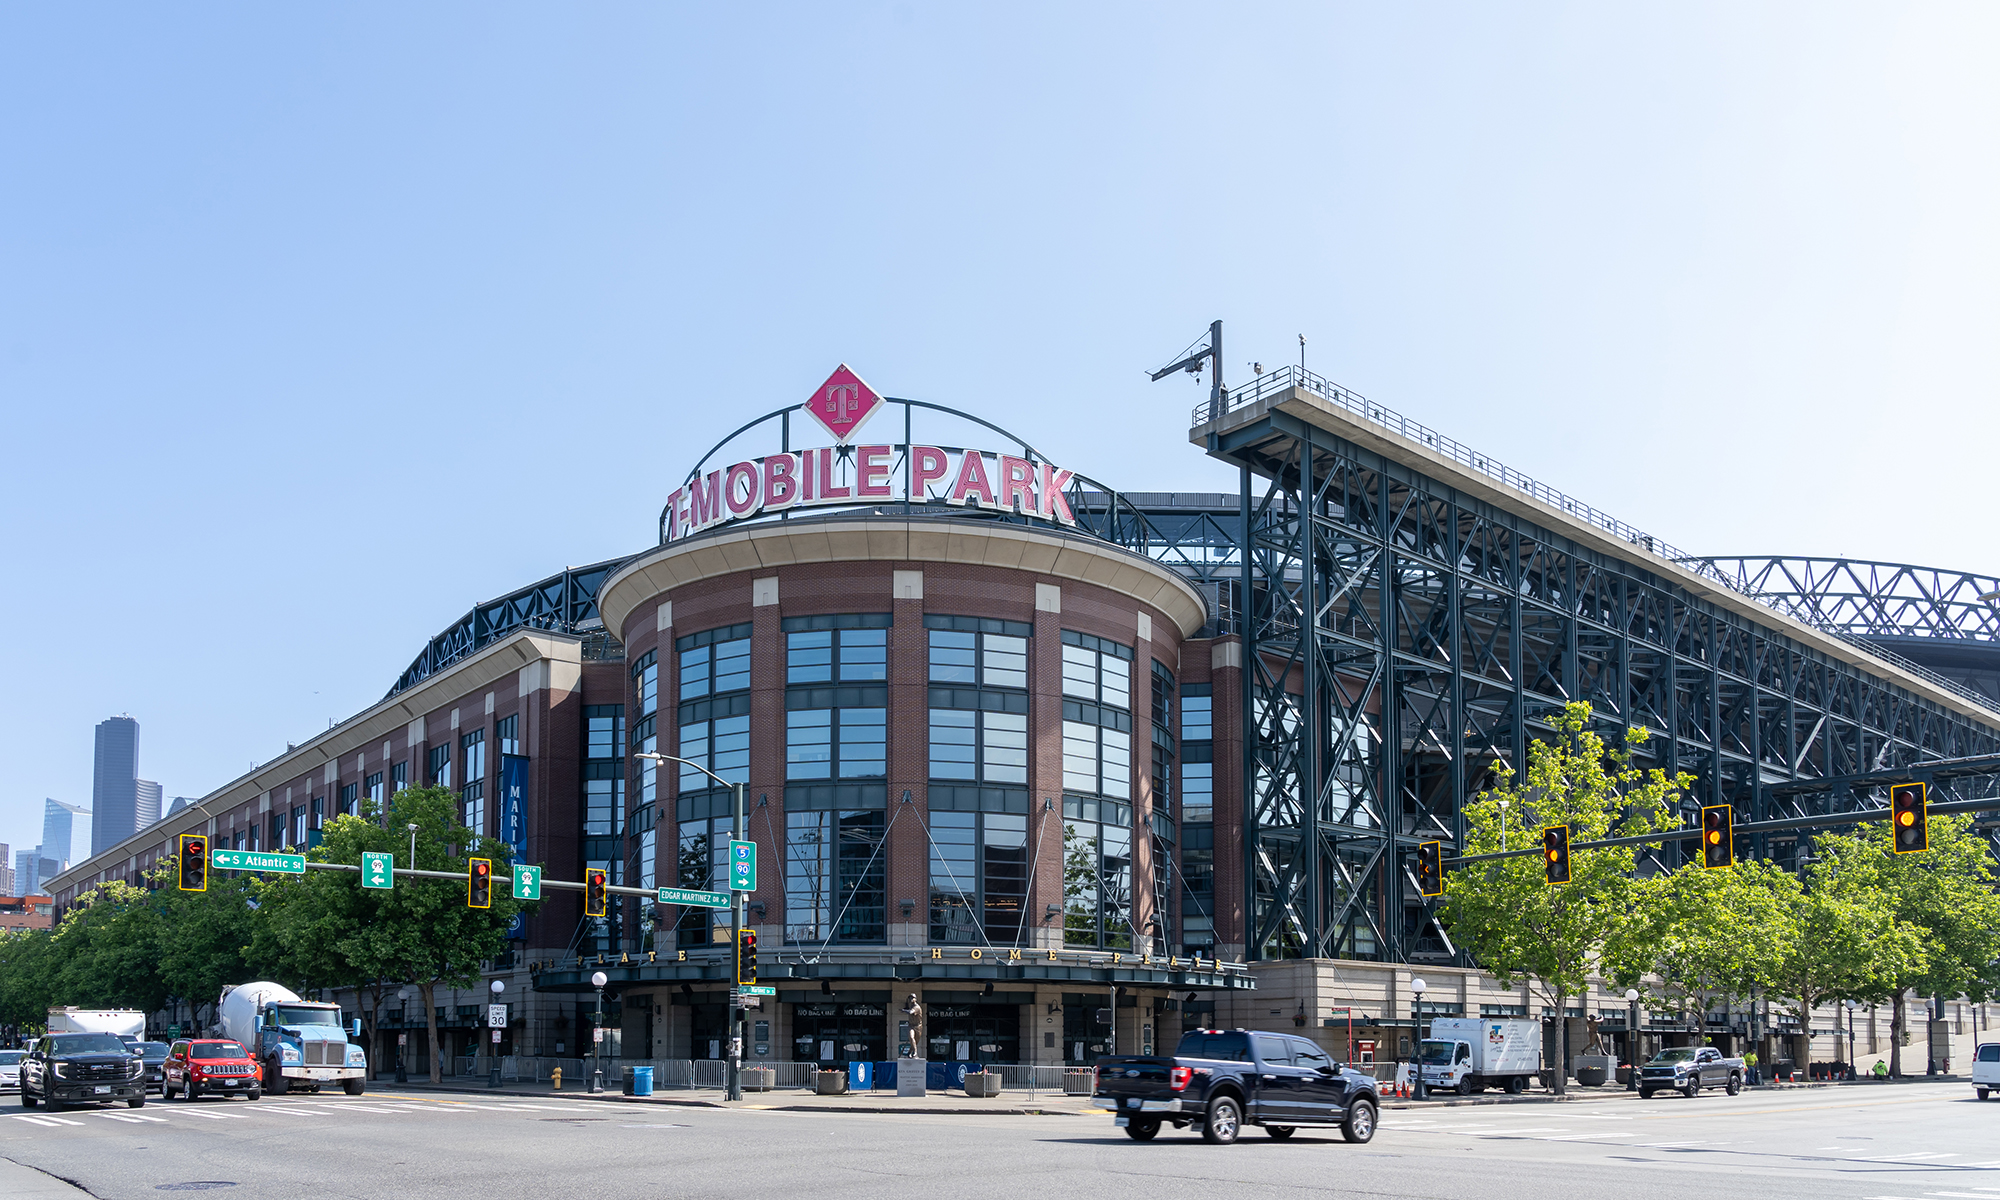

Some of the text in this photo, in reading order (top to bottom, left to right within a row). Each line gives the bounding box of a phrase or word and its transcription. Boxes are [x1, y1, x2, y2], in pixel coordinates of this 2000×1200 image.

[825, 383, 859, 424] T
[667, 444, 1076, 541] T-MOBILE PARK
[740, 849, 746, 858] 5
[232, 855, 301, 870] S Atlantic St
[373, 861, 383, 869] 99
[518, 865, 537, 873] SOUTH
[737, 865, 748, 874] 90
[522, 873, 532, 881] 99
[661, 890, 681, 900] EDGAR
[682, 892, 711, 903] MARTINEZ
[577, 950, 688, 966] PLATE
[931, 947, 1221, 970] HOME PLATE
[491, 1016, 505, 1025] 30
